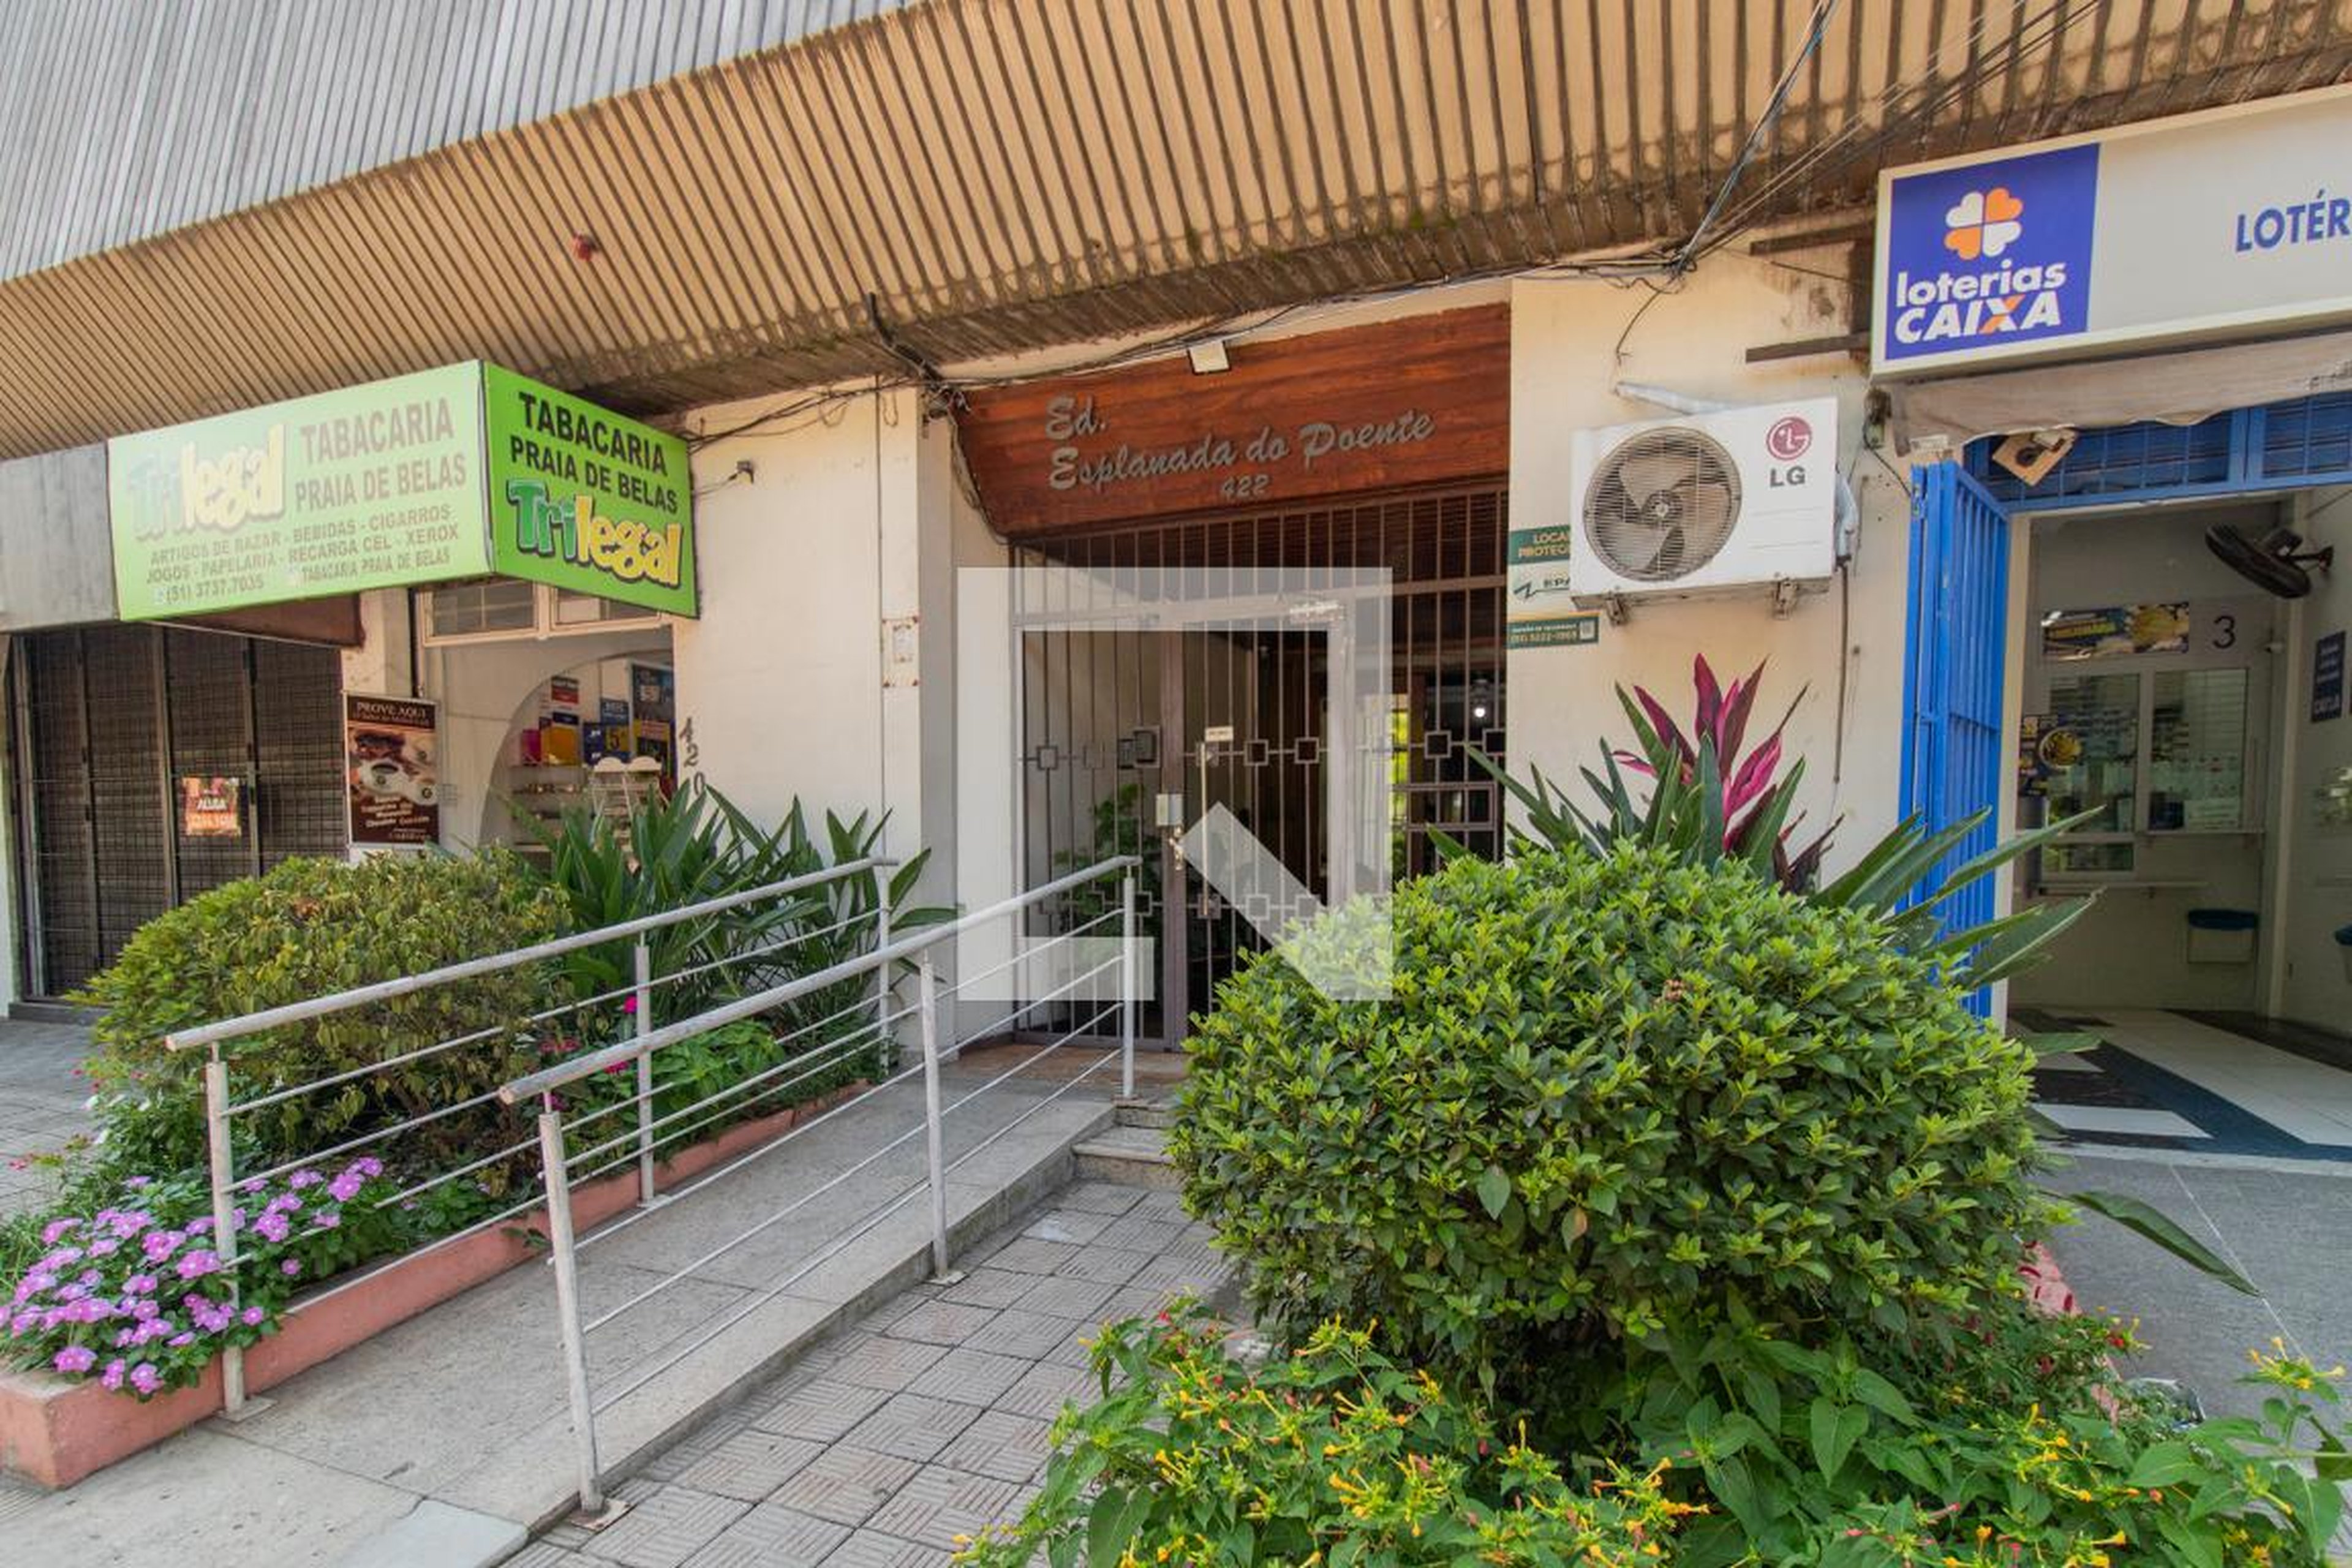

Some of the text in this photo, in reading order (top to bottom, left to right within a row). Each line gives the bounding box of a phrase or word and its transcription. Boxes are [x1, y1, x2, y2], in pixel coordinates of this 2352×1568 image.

[2236, 189, 2351, 252] LOTÉR
[1896, 259, 2067, 307] loterias
[1895, 290, 2061, 344] CAIXA
[300, 398, 455, 466] TABACARIA
[518, 391, 668, 477] TABACARIA
[1045, 395, 1106, 440] Ed.
[510, 435, 677, 515] PRAIA DE BELAS
[1049, 410, 1434, 492] Esplanada do Poente
[1770, 466, 1806, 488] LG
[295, 453, 467, 513] PRAIA DE BELAS
[147, 523, 459, 584] JOGOS PAPELARIA RECARGA CEL XEROX
[151, 503, 451, 566] ARTIGOS DE BAZAR BEBIDAS CIGARROS
[416, 546, 450, 567] BELAS
[2212, 616, 2236, 649] 3
